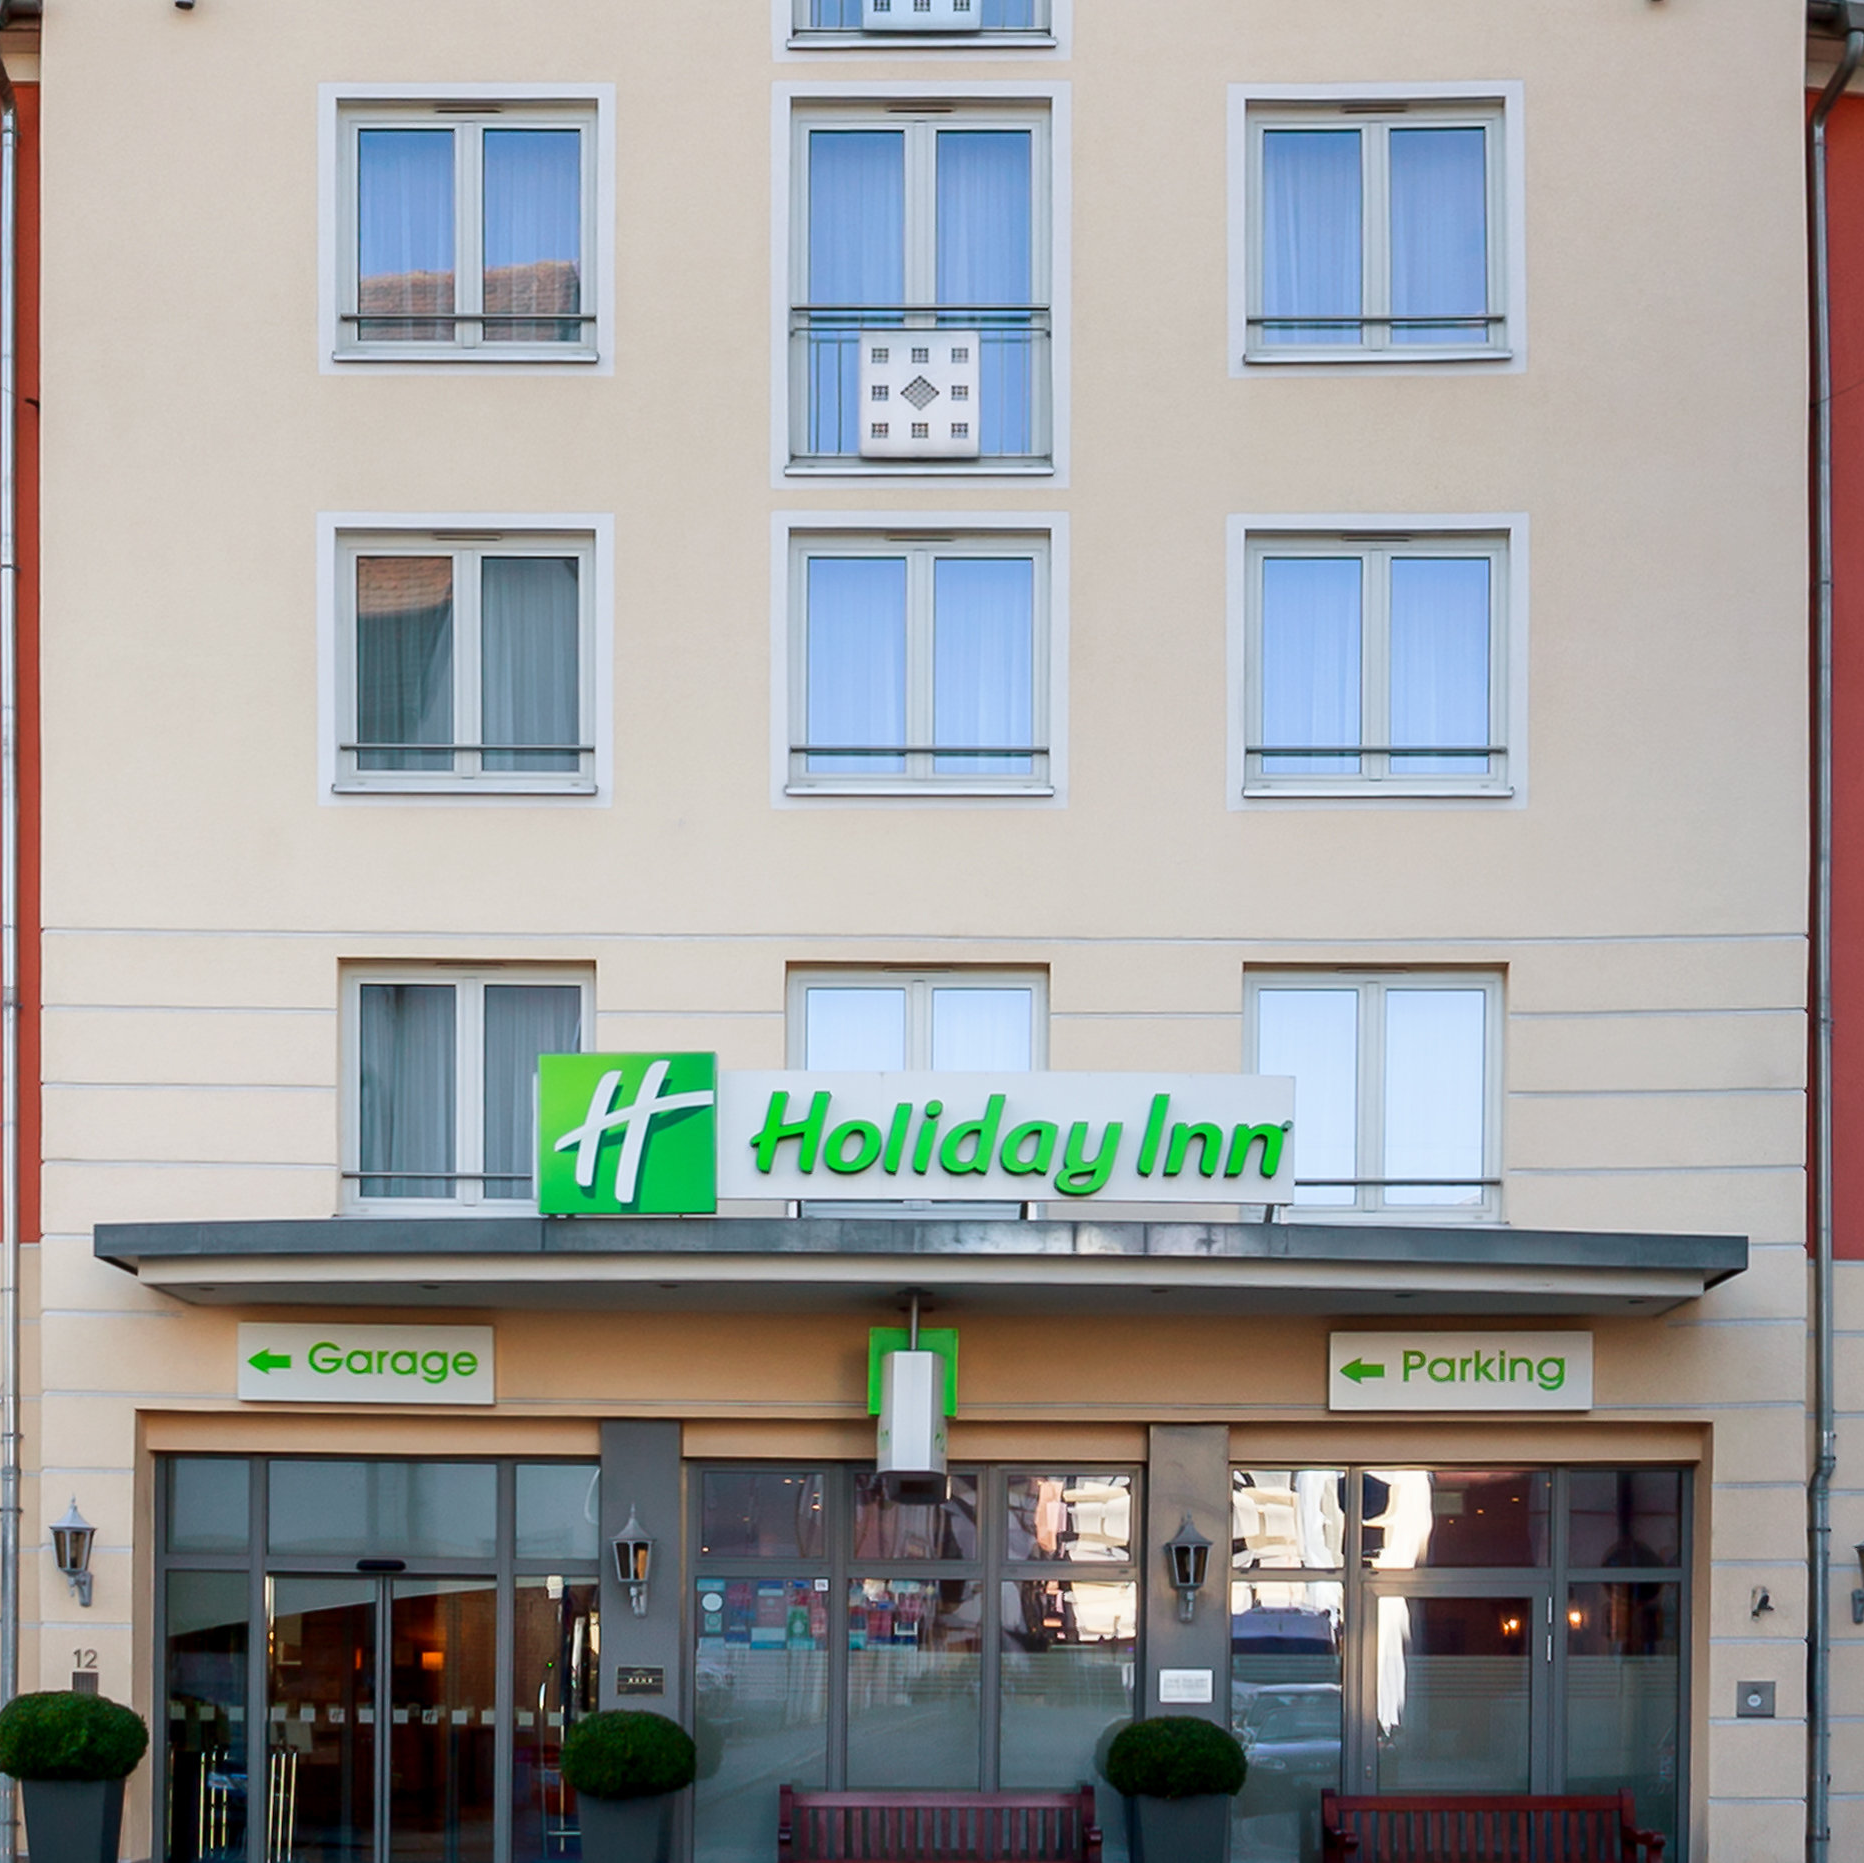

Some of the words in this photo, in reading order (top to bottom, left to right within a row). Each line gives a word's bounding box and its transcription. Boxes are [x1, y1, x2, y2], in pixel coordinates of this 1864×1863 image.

[750, 1089, 1124, 1197] Holiday
[1137, 1092, 1290, 1179] Inn
[307, 1341, 479, 1384] Garage
[1402, 1349, 1566, 1391] Parking
[73, 1648, 98, 1669] 12
